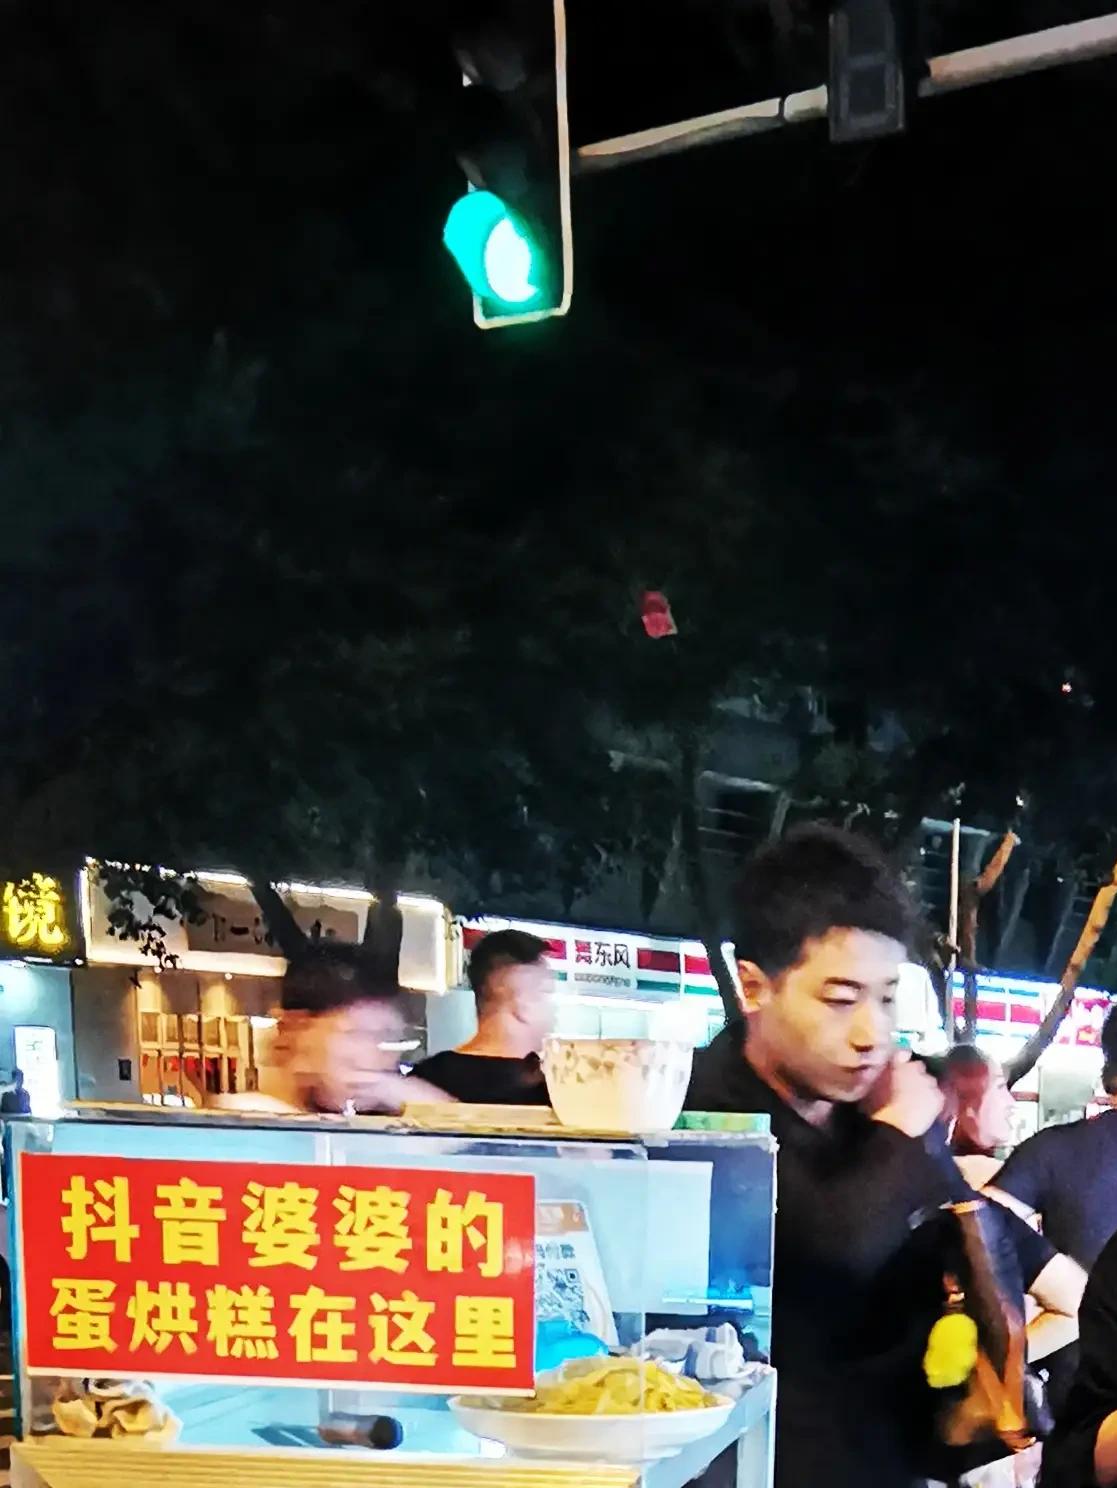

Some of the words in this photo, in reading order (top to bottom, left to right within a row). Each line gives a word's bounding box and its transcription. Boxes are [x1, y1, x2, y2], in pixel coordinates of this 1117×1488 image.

[60, 1175, 505, 1278] 抖音婆婆的
[50, 1277, 518, 1370] 蛋烘糕在这里
